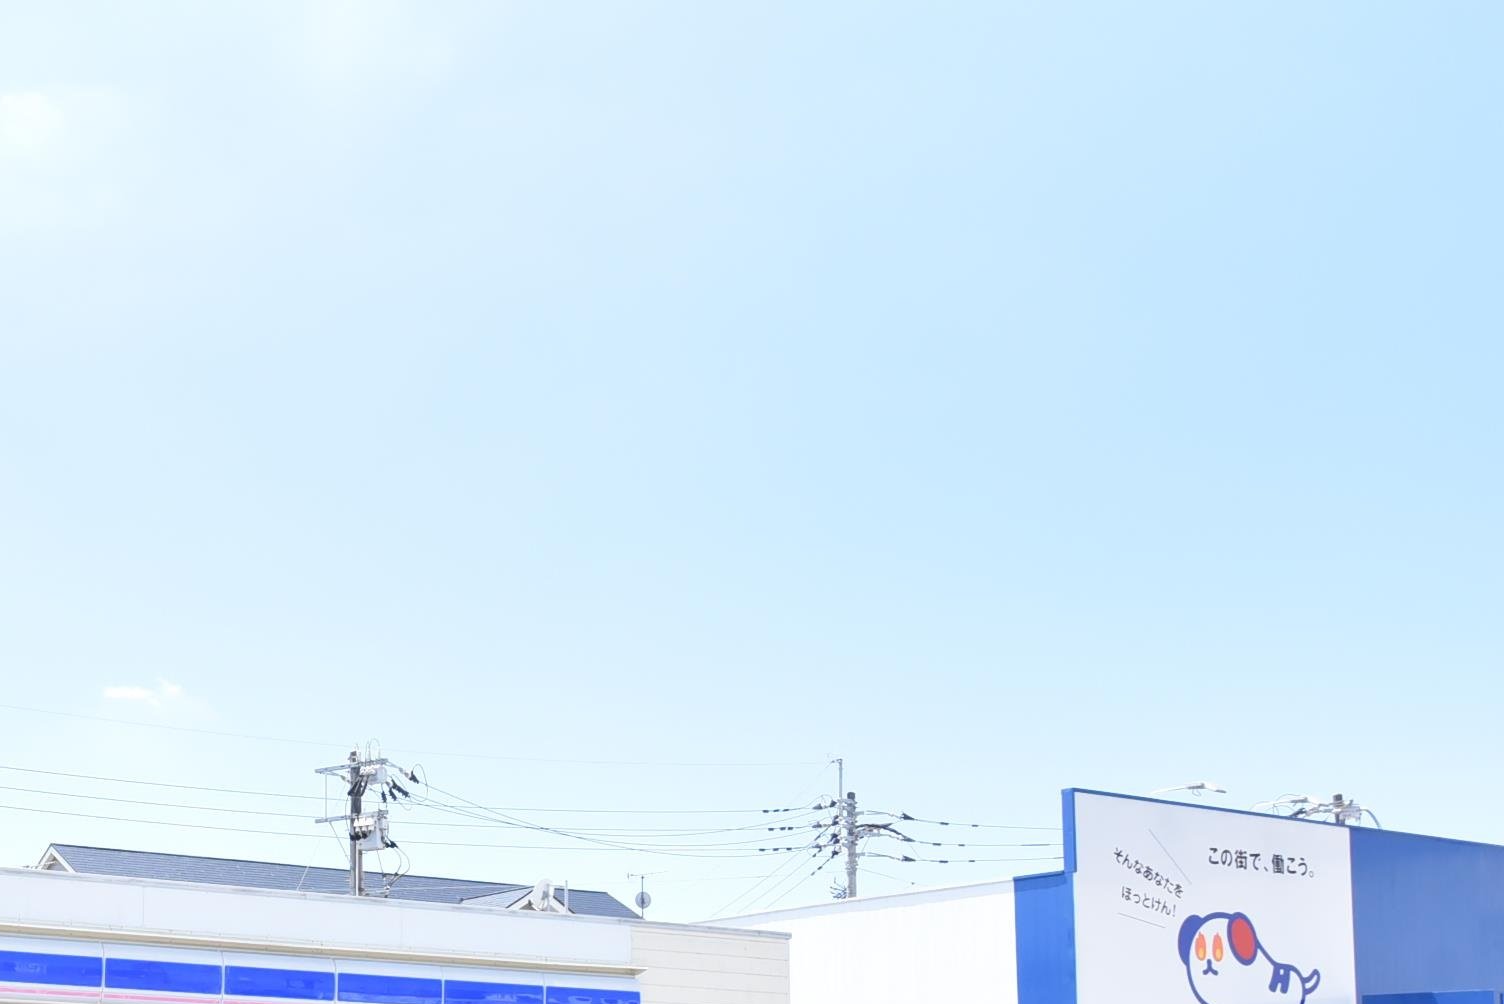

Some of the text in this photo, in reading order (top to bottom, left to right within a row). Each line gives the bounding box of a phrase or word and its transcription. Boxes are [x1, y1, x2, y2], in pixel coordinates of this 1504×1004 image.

[1113, 847, 1184, 899] そんなあなたを
[1207, 847, 1314, 878] この街で、働こう。
